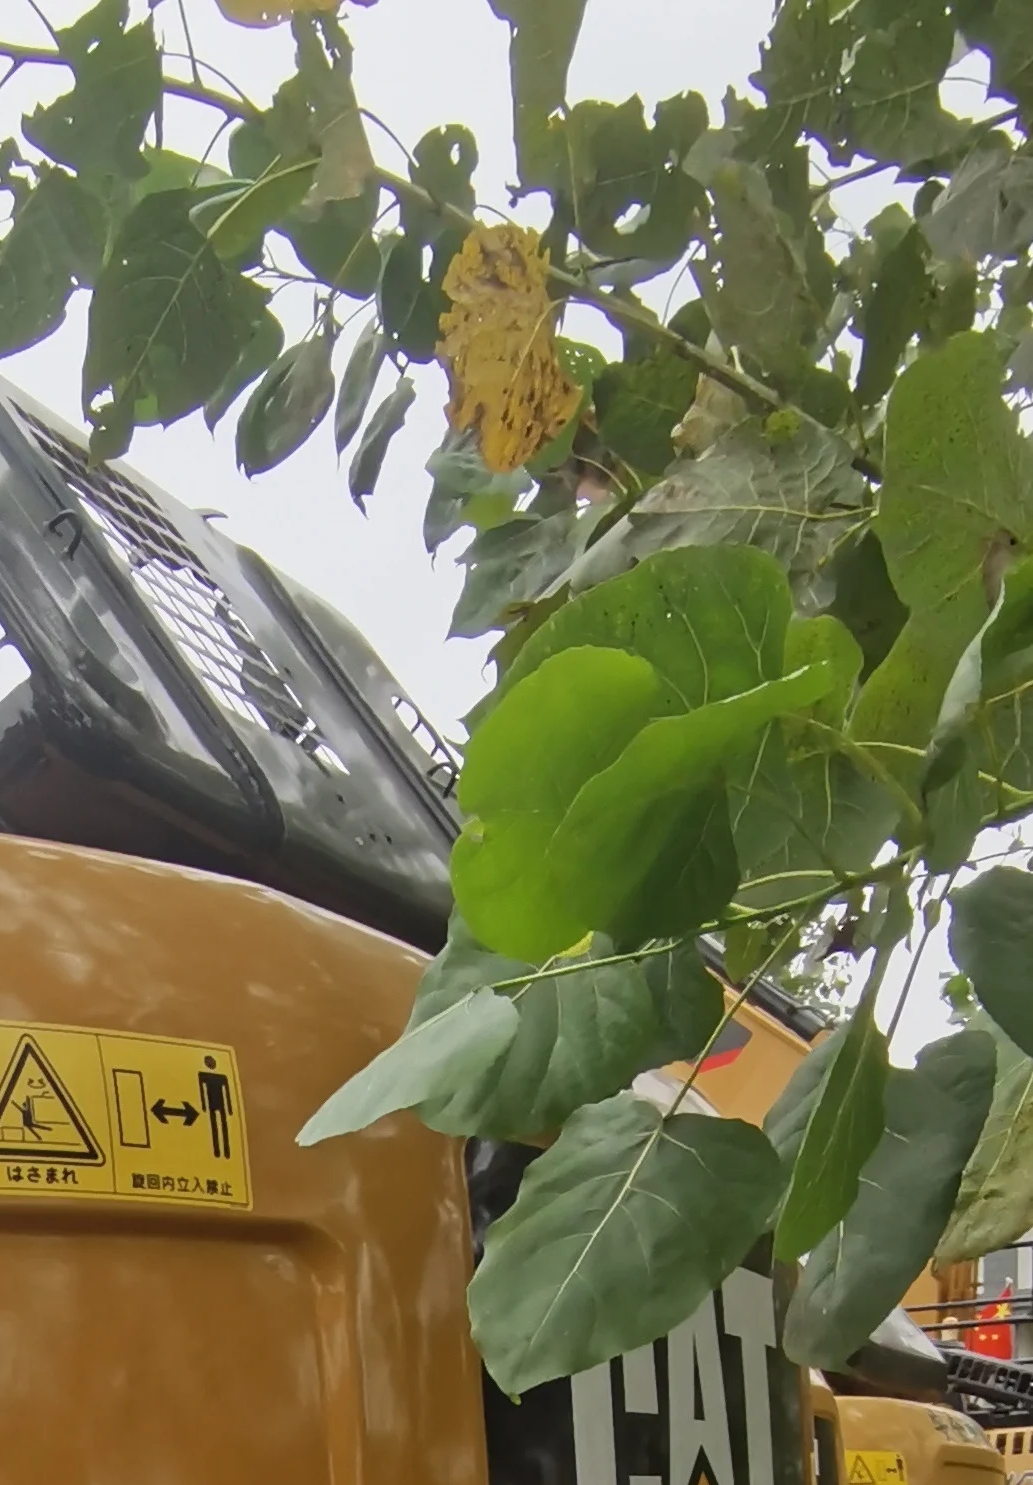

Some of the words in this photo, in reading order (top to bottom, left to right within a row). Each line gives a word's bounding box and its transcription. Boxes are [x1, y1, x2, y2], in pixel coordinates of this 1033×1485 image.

[6, 1165, 79, 1185] はさまれ
[131, 1172, 234, 1197] 旋回内立入禁止
